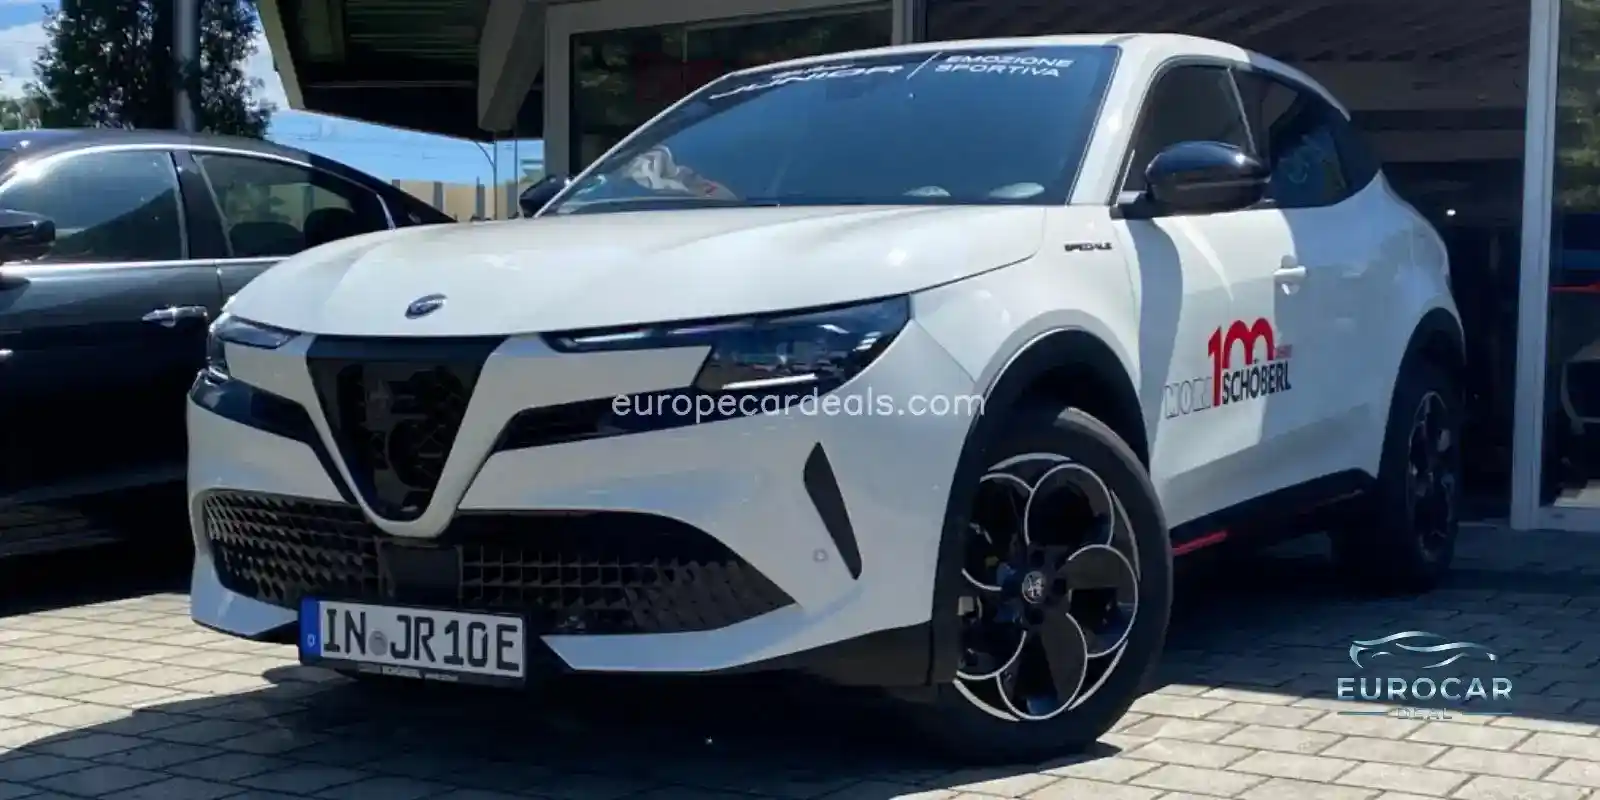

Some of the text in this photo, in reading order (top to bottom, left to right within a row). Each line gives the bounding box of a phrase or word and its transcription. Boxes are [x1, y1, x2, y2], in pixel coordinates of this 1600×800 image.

[945, 55, 1074, 68] EMOZIONE
[935, 64, 1060, 77] SPORTIVA
[1222, 358, 1292, 405] SCHÖBERL
